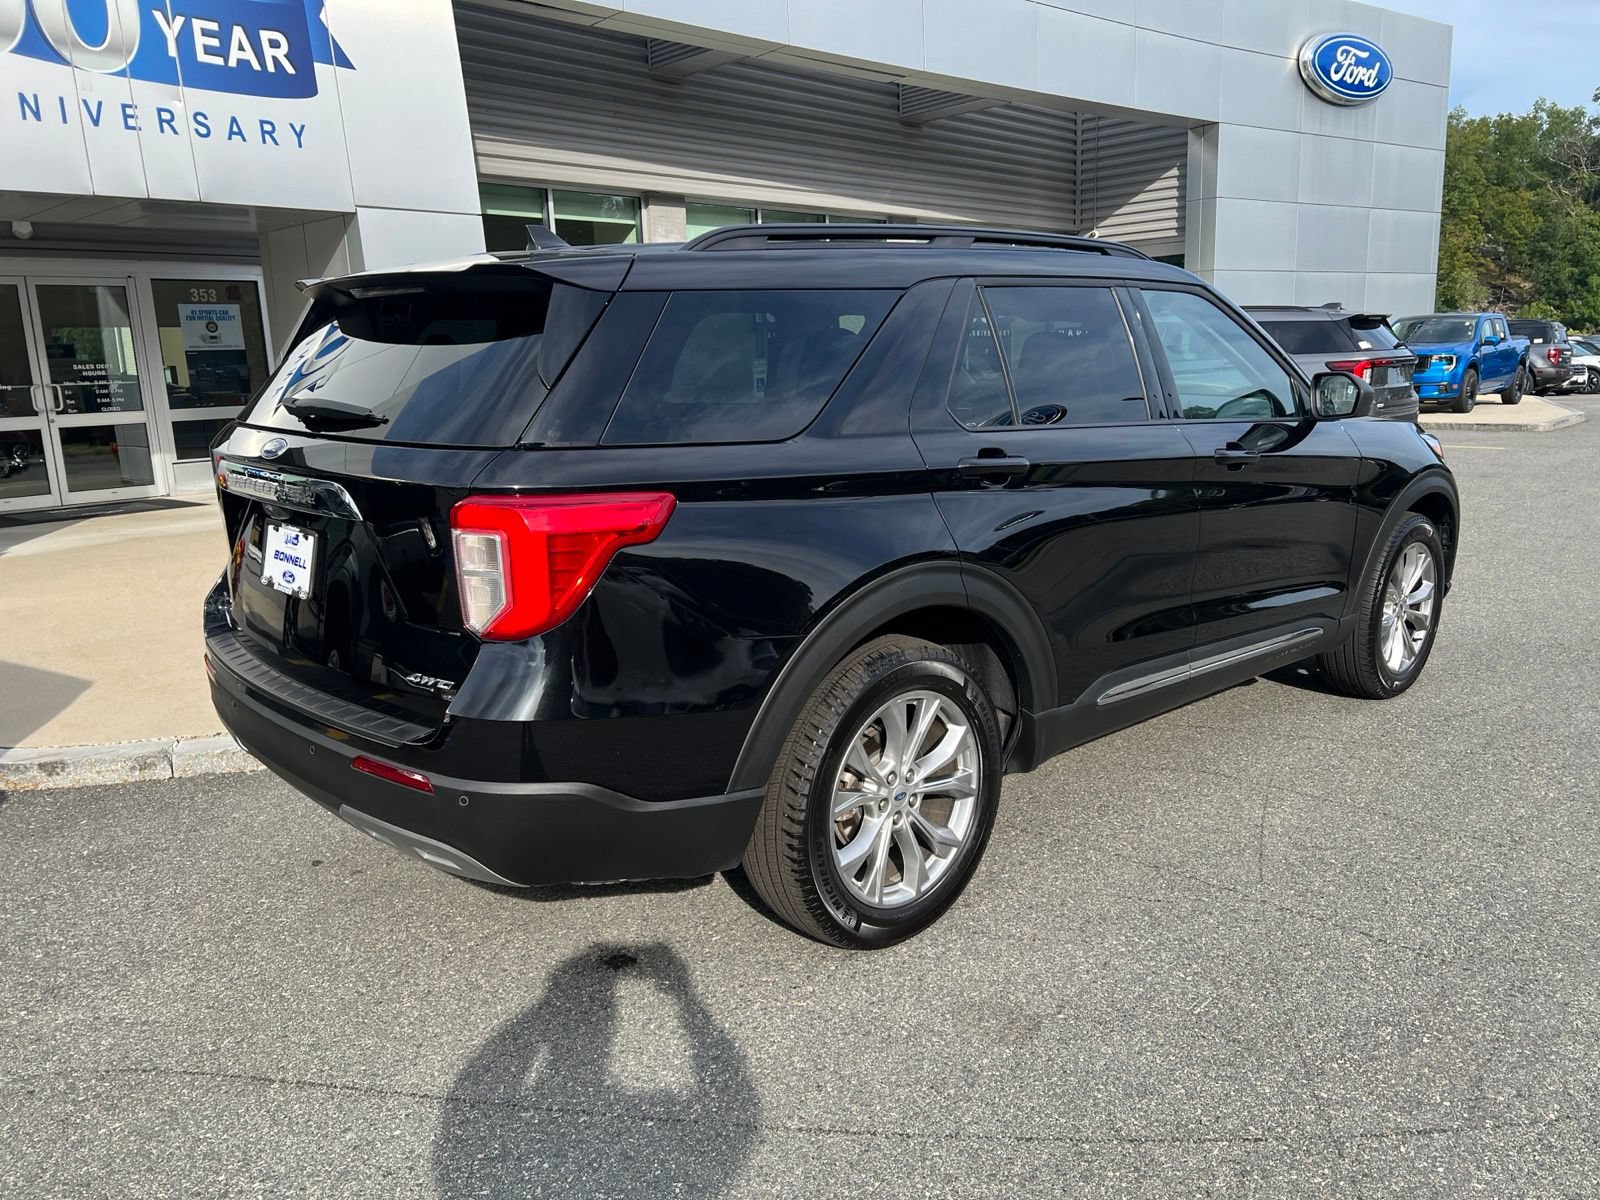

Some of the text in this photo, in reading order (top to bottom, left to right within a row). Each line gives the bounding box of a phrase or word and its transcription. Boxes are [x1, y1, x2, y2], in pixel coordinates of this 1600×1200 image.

[152, 9, 297, 75] YEAR
[1329, 45, 1380, 88] Ford
[17, 92, 307, 149] NIVERSARY
[190, 288, 217, 302] 353
[273, 550, 307, 570] BONNELL
[815, 840, 844, 911] MICHELIN
